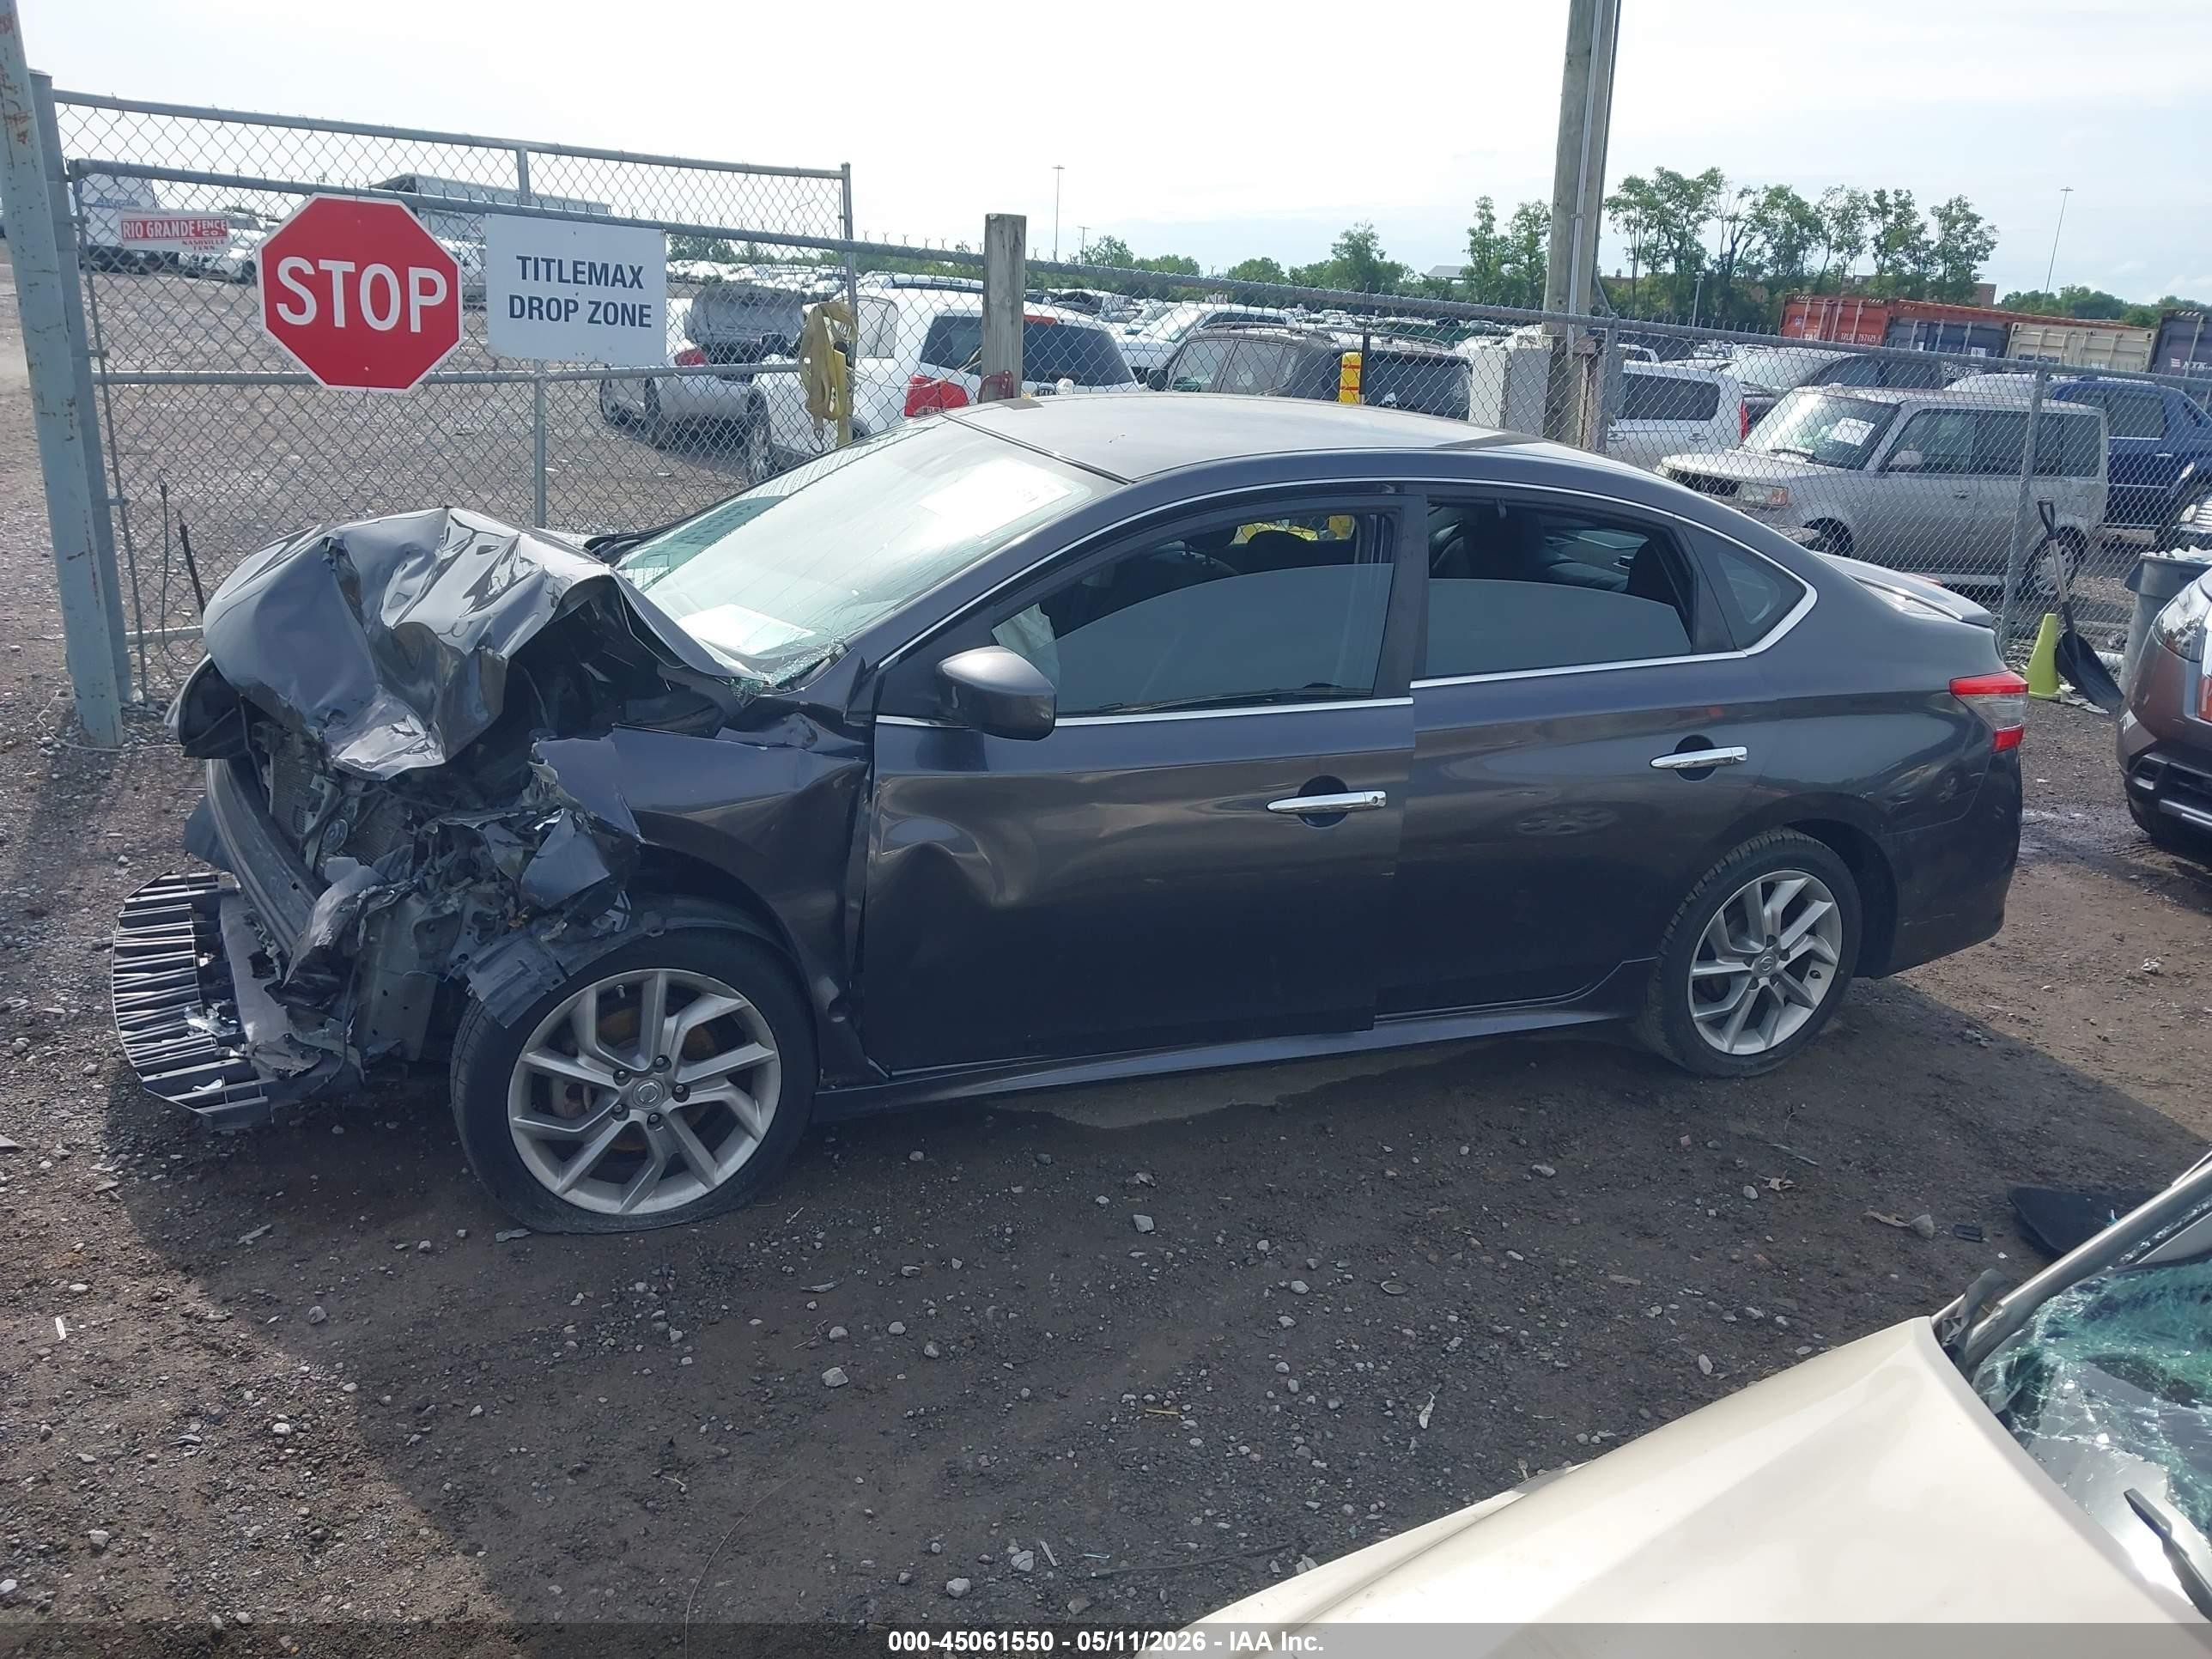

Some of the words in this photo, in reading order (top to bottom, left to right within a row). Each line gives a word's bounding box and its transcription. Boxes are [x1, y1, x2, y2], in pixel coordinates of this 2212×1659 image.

[122, 220, 143, 239] RIO
[146, 219, 196, 238] GRANDE
[197, 219, 227, 232] FENCE
[515, 255, 644, 290] TITLEMAX
[276, 256, 448, 334] STOP
[508, 295, 580, 323] DROP
[587, 300, 653, 329] ZONE
